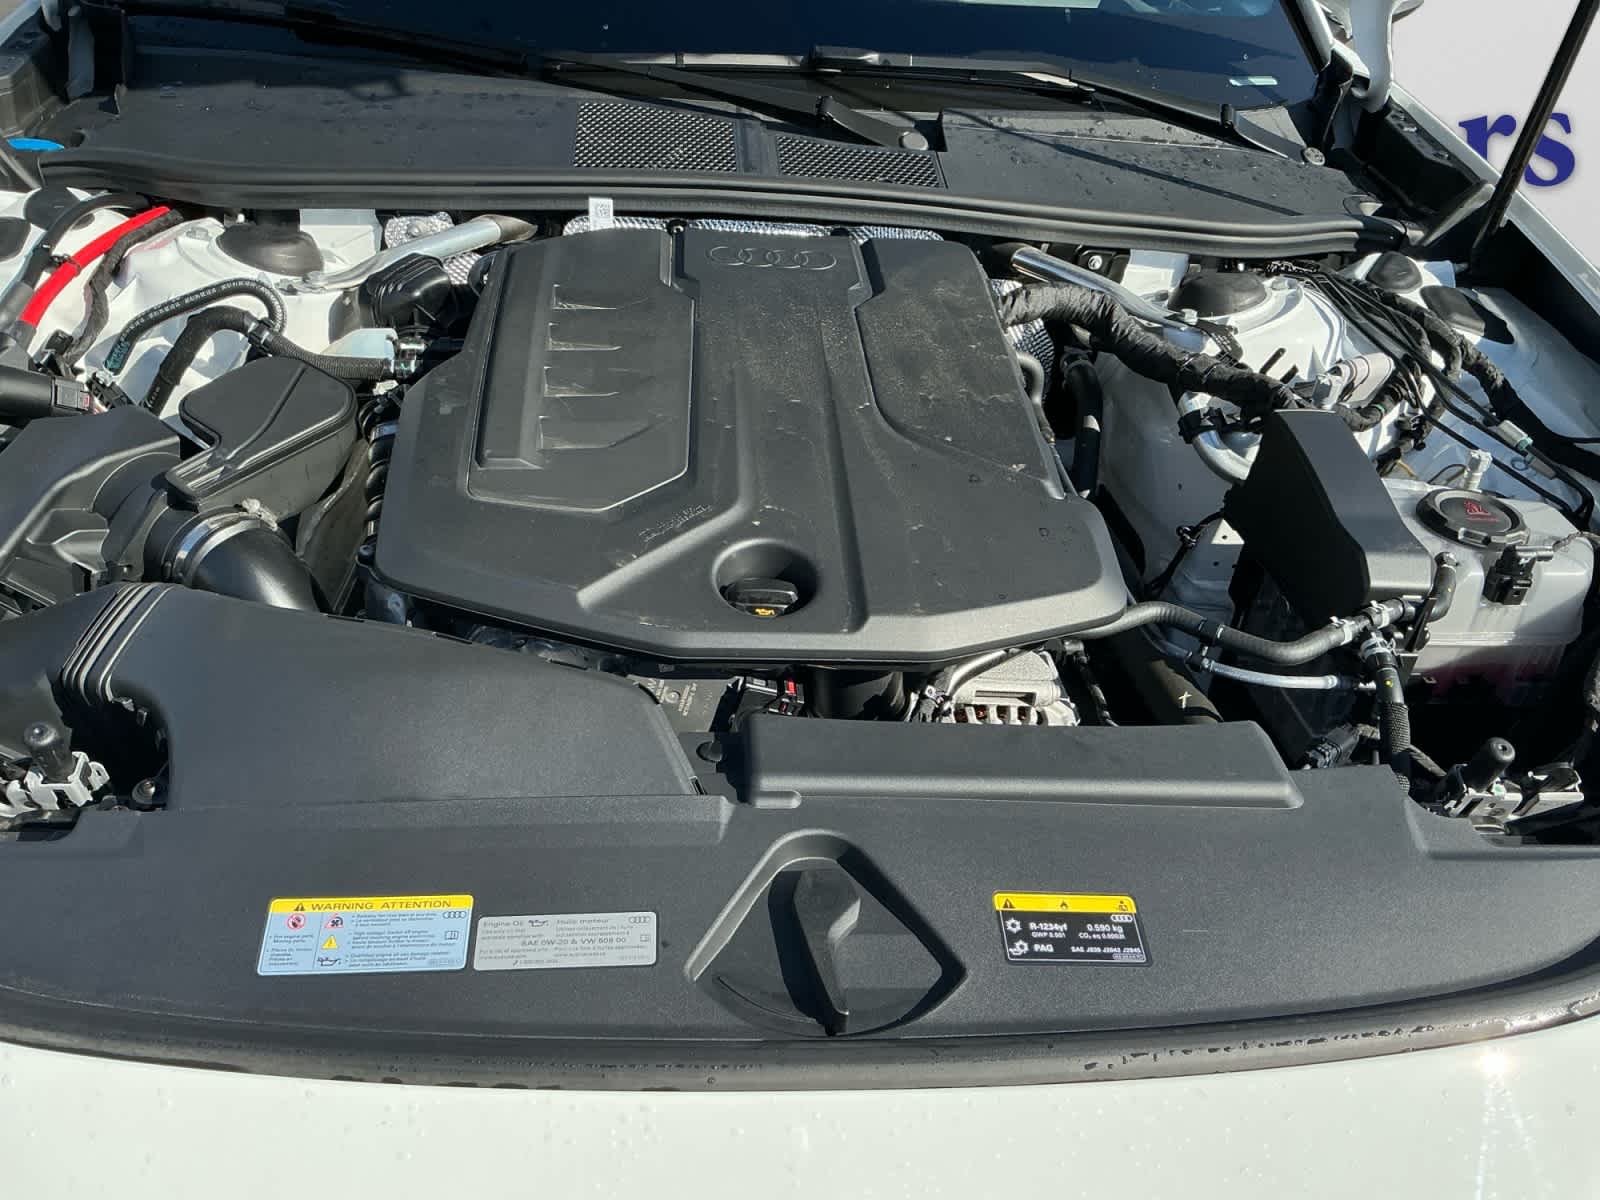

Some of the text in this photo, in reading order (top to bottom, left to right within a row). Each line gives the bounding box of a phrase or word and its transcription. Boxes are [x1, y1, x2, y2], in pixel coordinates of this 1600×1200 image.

[311, 900, 451, 911] WARNING ATTENTION
[483, 920, 510, 928] Engine
[1029, 922, 1068, 932] R-1234yf
[1086, 924, 1123, 934] 0.590 kg
[1033, 944, 1054, 952] PAG
